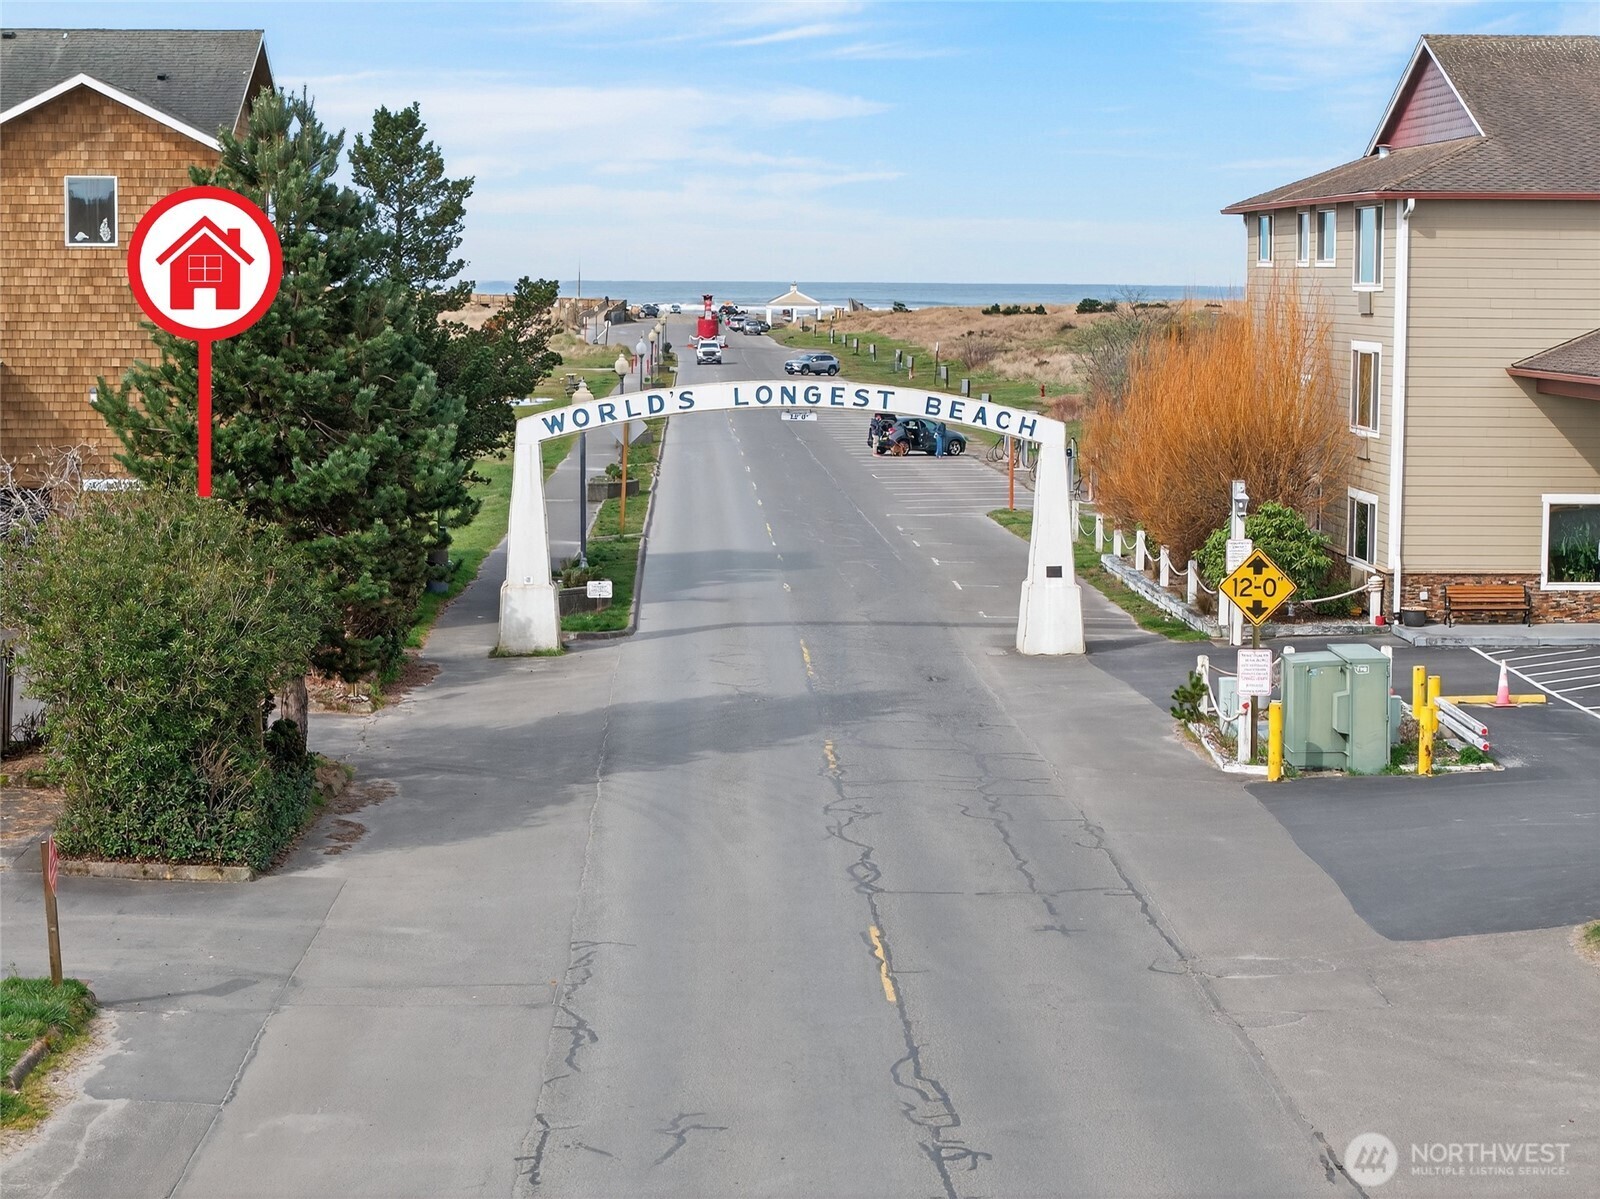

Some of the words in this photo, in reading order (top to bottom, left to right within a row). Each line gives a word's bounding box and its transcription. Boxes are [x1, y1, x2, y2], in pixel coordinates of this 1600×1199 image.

[542, 390, 695, 434] WORLD'S
[734, 385, 895, 409] LONGEST
[925, 396, 1037, 437] BEACH
